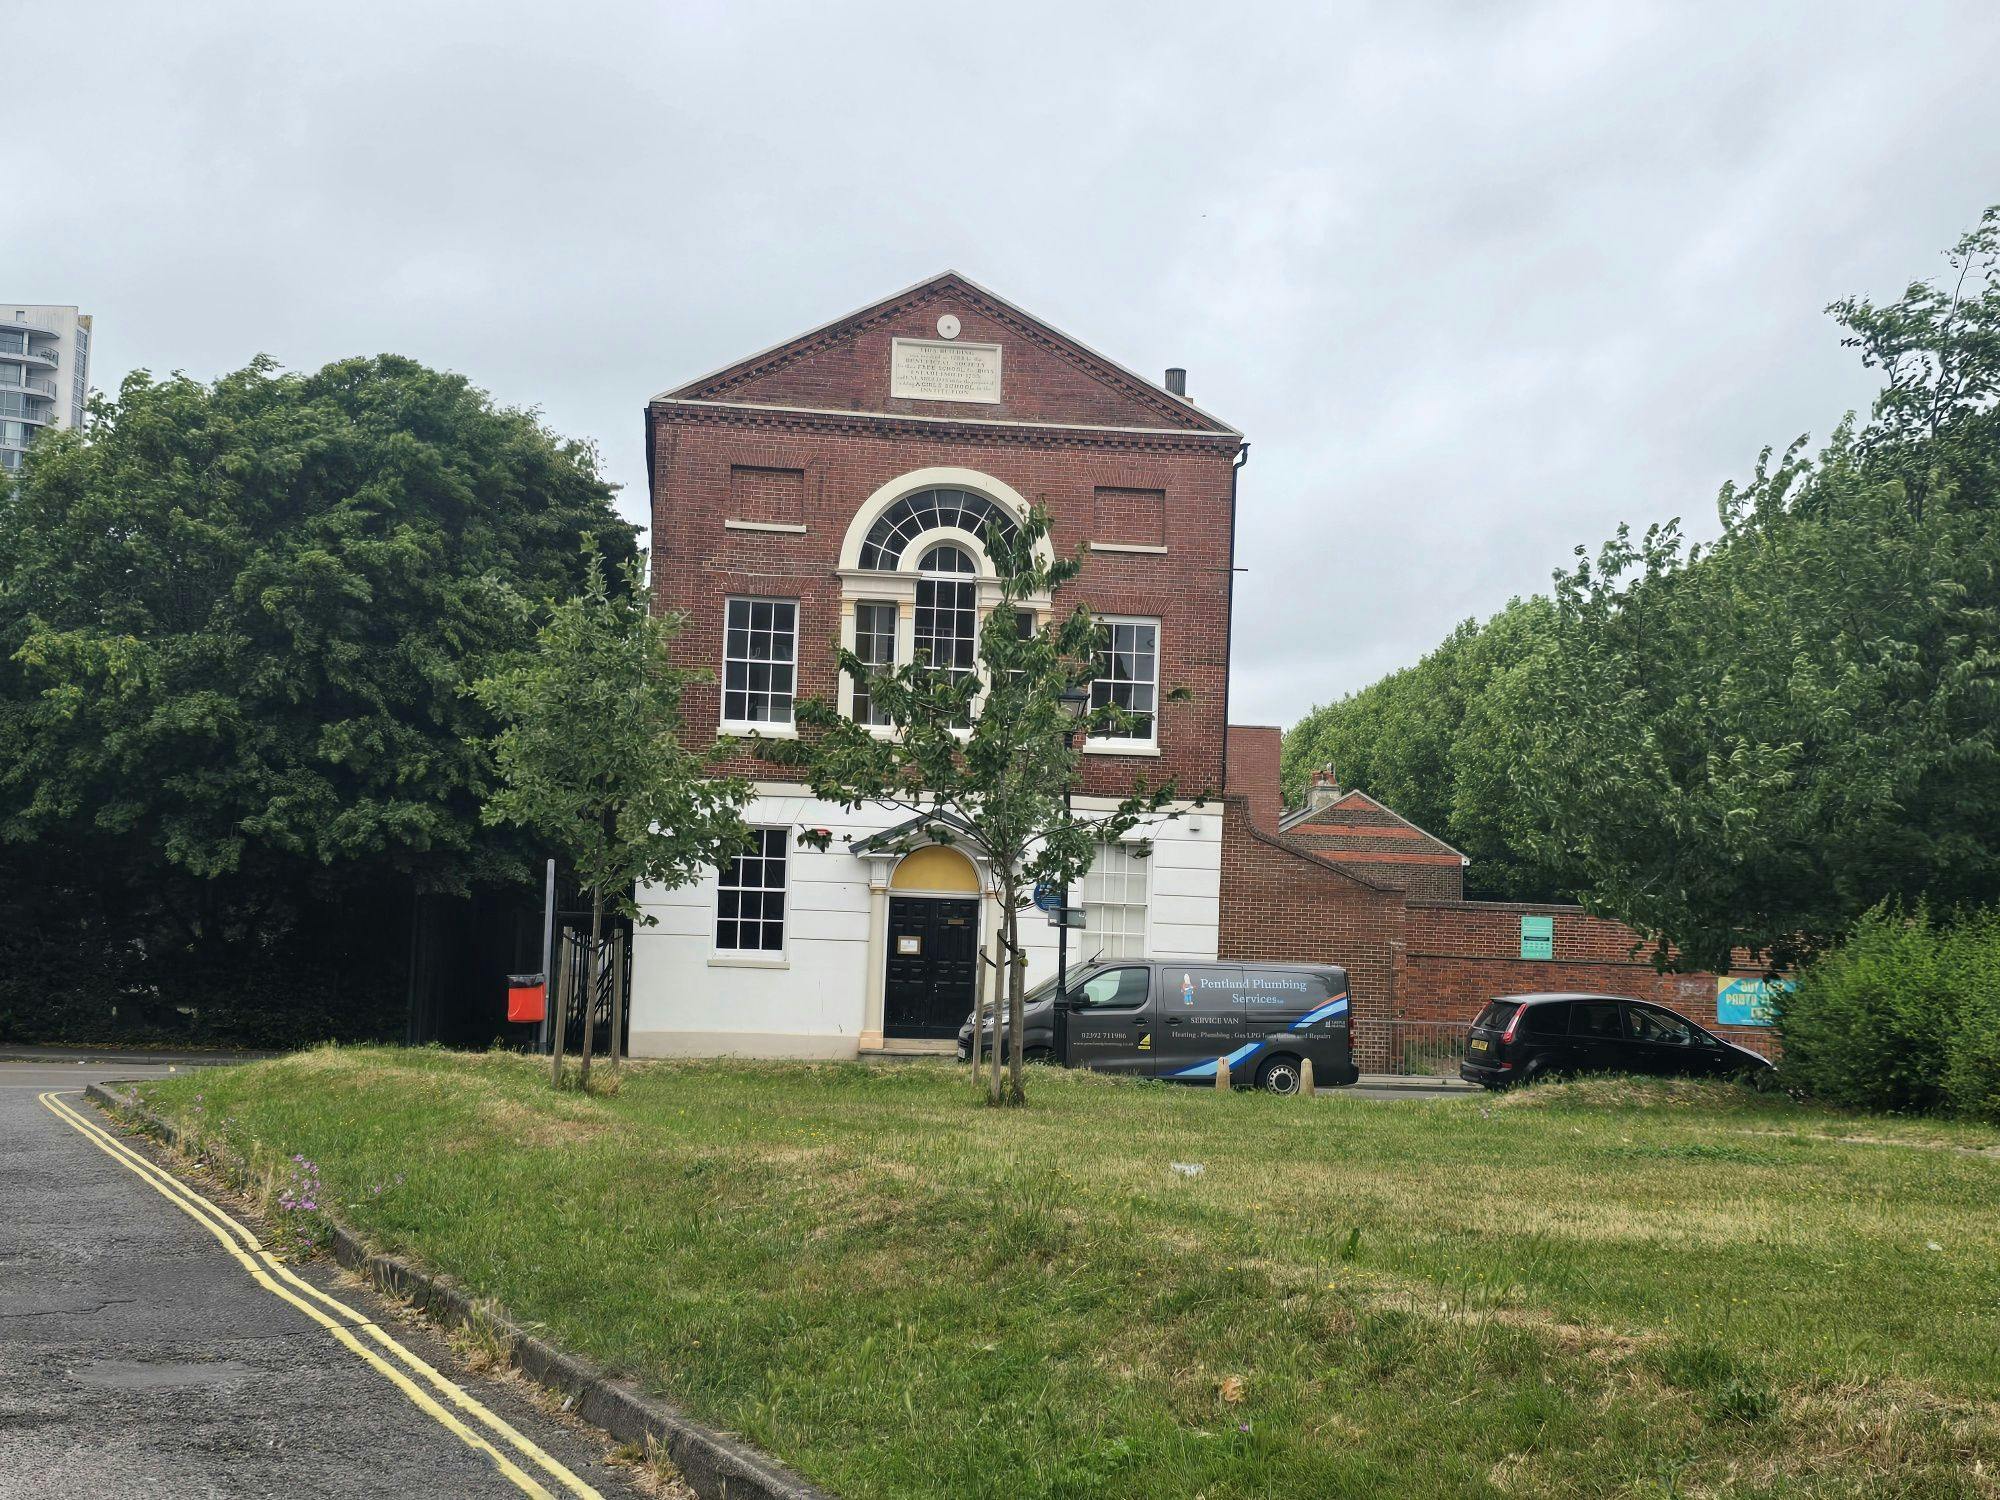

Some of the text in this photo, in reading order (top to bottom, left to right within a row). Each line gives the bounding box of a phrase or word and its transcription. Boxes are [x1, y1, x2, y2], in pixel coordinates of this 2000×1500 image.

[1200, 978, 1307, 992] Pentland Plumbing
[1232, 993, 1277, 1004] Services
[1190, 1017, 1222, 1025] SERVICE
